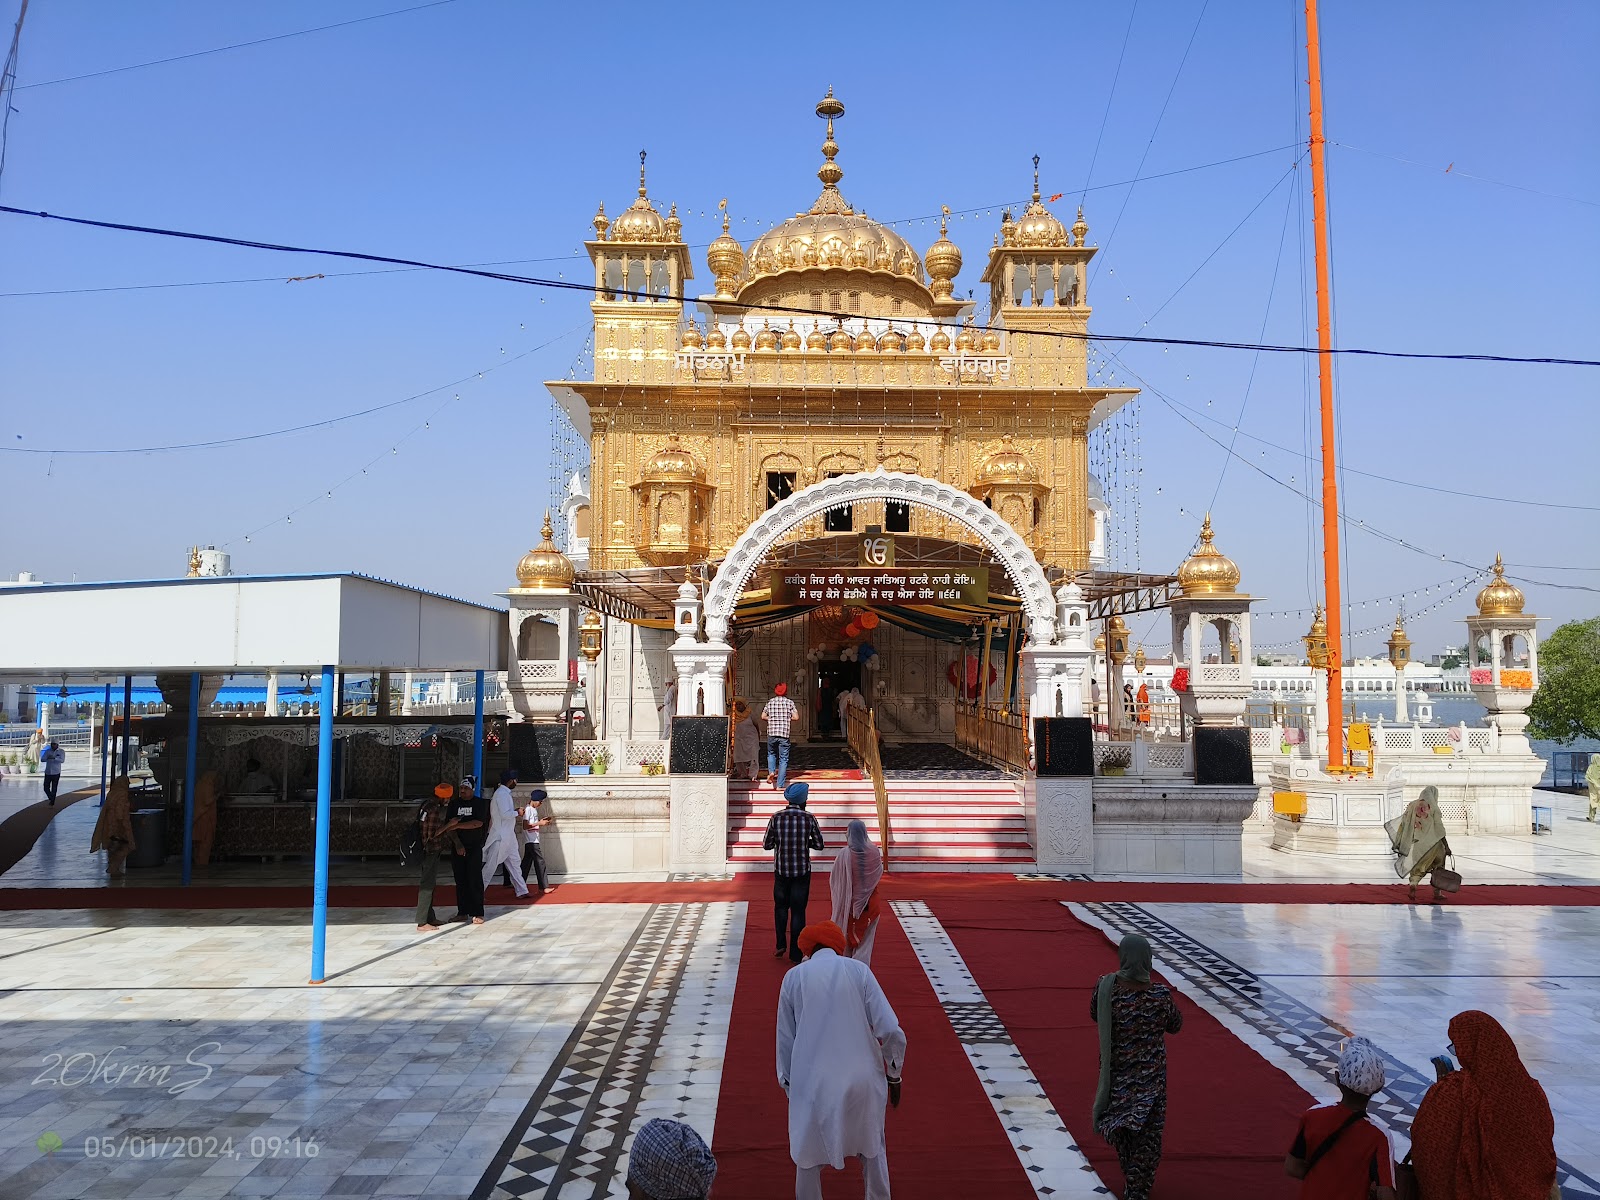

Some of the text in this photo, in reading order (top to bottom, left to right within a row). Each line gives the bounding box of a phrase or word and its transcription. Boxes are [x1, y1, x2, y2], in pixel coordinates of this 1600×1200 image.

[939, 351, 1013, 380] ਵਾਹਿਗੁਰੂ
[784, 573, 806, 585] ਕਬੀਰ
[809, 573, 826, 585] ਜਿਹ
[828, 573, 844, 585] ਦਰਿ
[847, 575, 871, 585] ਆਵਤ
[873, 573, 907, 587] ਜਾਤਿਅਹੁ
[909, 573, 929, 585] ਹਟਕੈ
[932, 573, 951, 585] ਨਾਹੀ
[799, 587, 807, 599] ਸੋ
[809, 590, 823, 601] ਦਰੁ
[825, 587, 840, 599] ਕੈਸੇ
[870, 587, 879, 599] ਜੋ
[881, 590, 895, 601] ਦਰੁ
[897, 587, 916, 599] ਐਸਾ
[918, 587, 935, 599] ਹੋਇ
